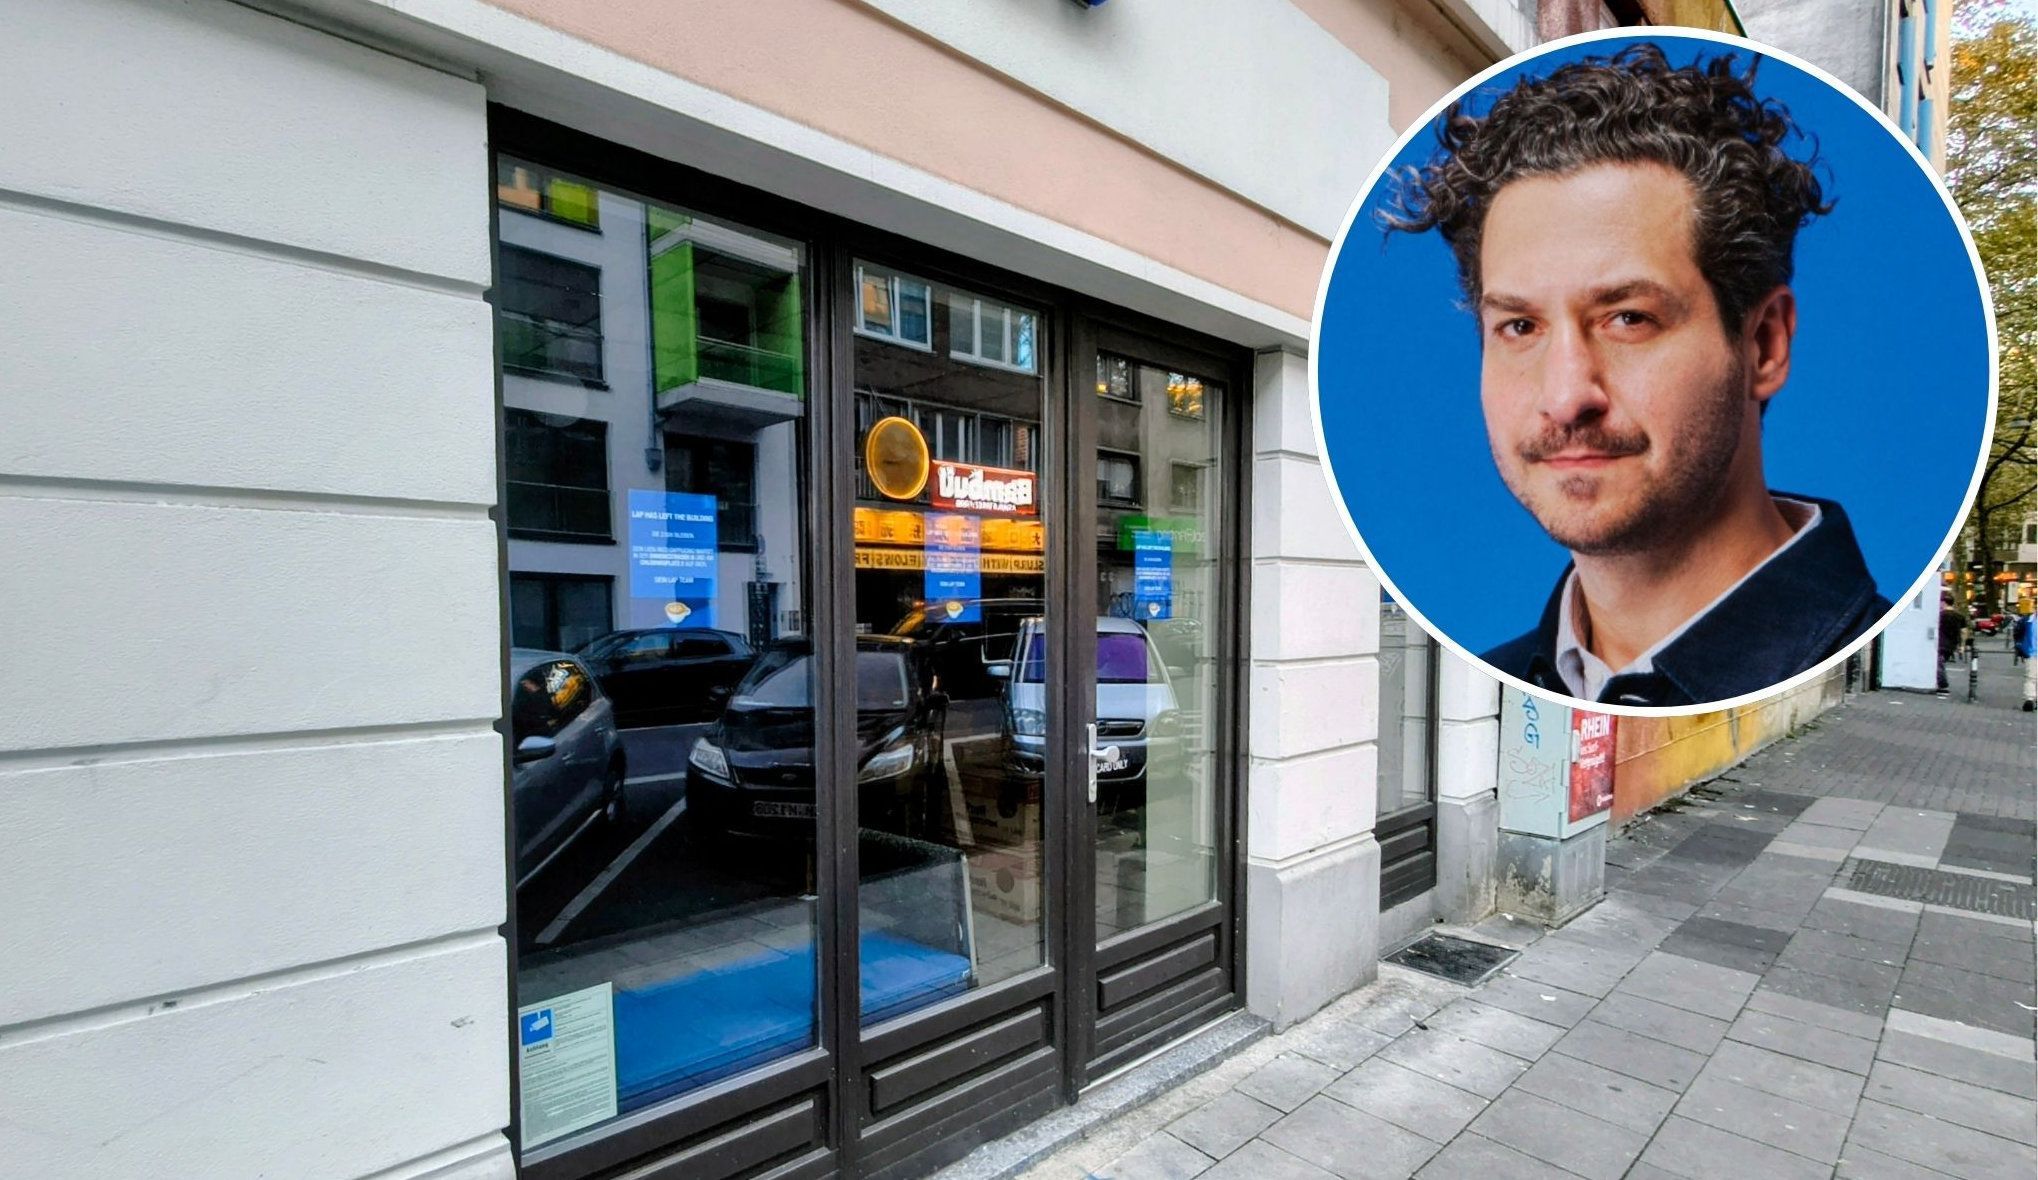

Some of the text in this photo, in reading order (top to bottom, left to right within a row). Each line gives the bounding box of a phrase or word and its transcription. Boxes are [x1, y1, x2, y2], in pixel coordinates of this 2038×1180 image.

[658, 512, 672, 520] LEFT
[1580, 714, 1610, 741] RHEIN
[1097, 758, 1128, 773] CARD ONLY
